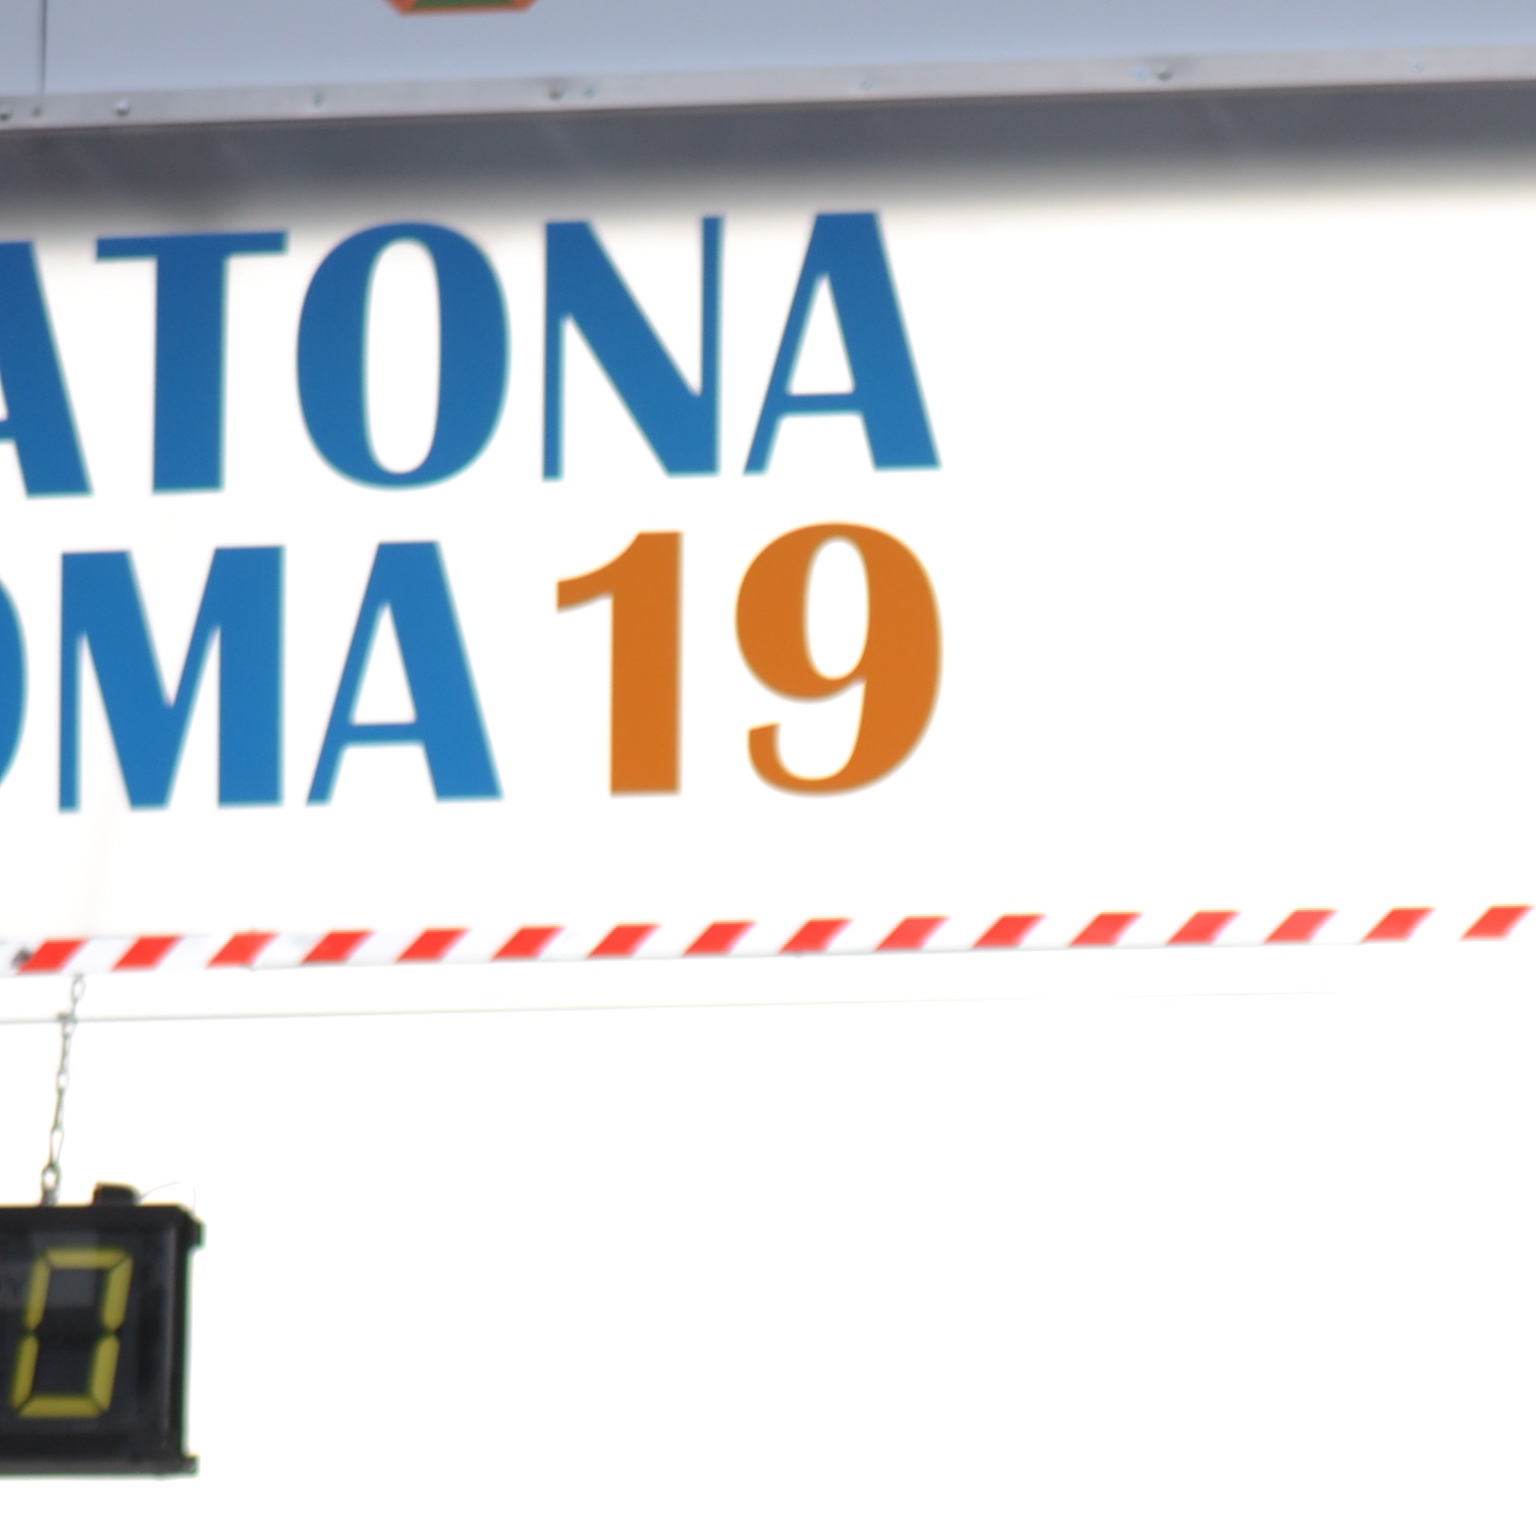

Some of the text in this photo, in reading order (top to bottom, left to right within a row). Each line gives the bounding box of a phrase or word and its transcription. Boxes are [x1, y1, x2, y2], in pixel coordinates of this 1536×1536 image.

[0, 521, 943, 814] MA 19
[11, 1247, 133, 1418] 0
